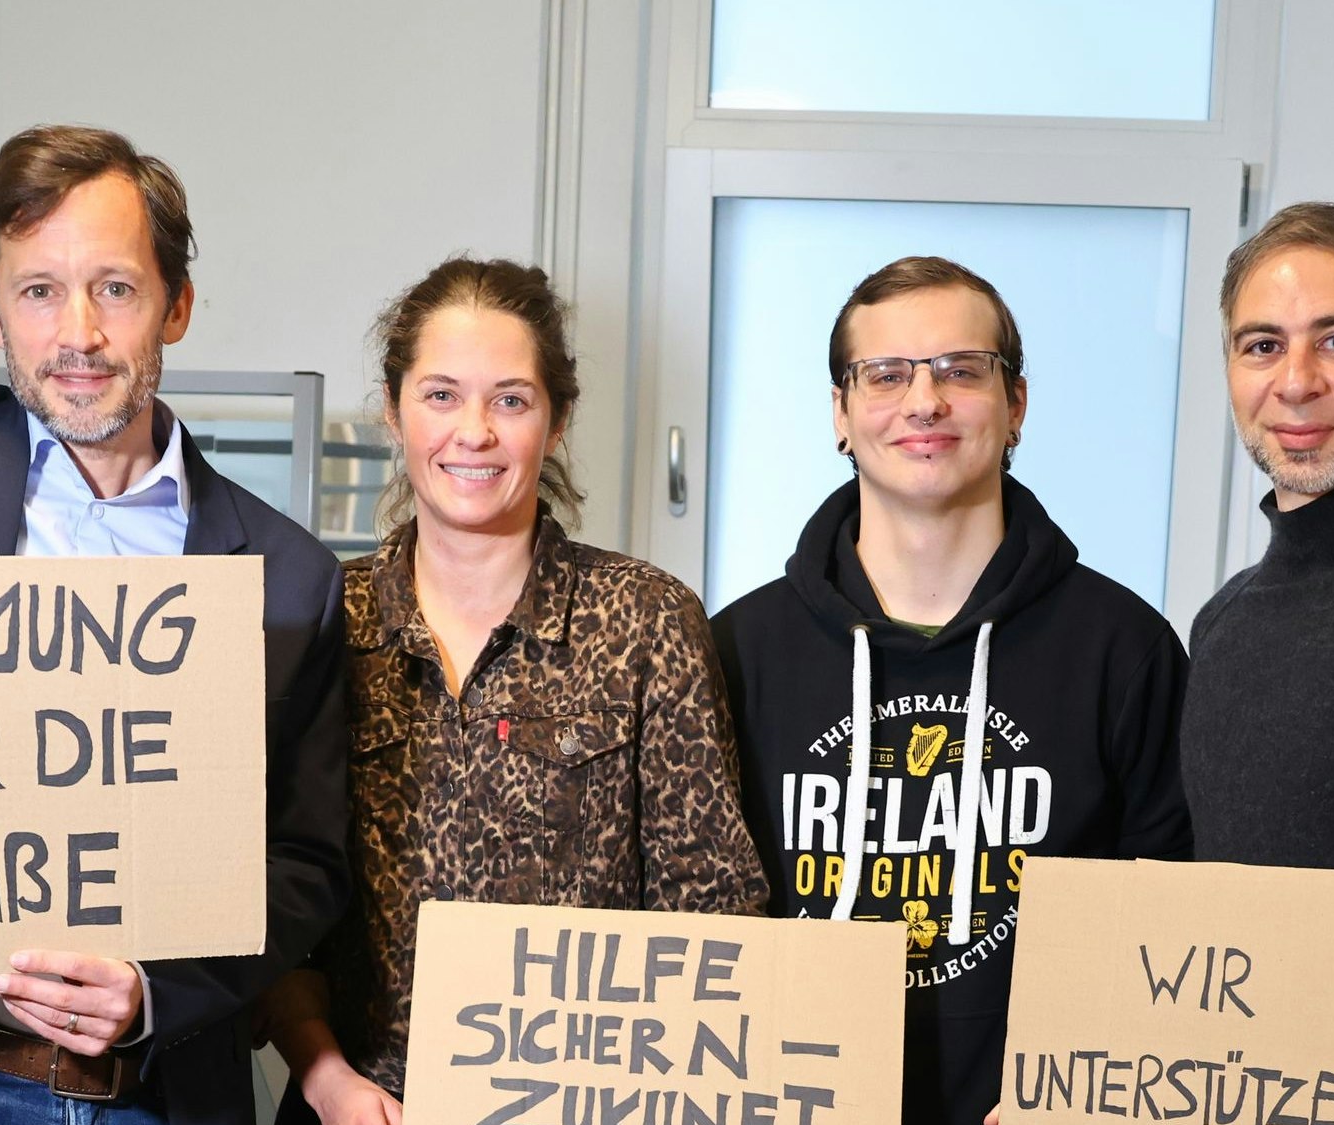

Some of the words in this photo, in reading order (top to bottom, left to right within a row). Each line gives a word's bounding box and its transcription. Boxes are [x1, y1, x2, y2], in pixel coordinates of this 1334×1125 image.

[35, 707, 179, 786] DIE
[808, 715, 854, 758] THE
[868, 693, 971, 723] MERAL
[781, 765, 1053, 855] IRELAND
[795, 848, 1028, 899] ORGINLS
[512, 927, 743, 1003] HILFE
[905, 904, 1019, 989] OLLECTION
[1140, 945, 1256, 1018] WIR
[450, 1002, 750, 1080] SICHERN
